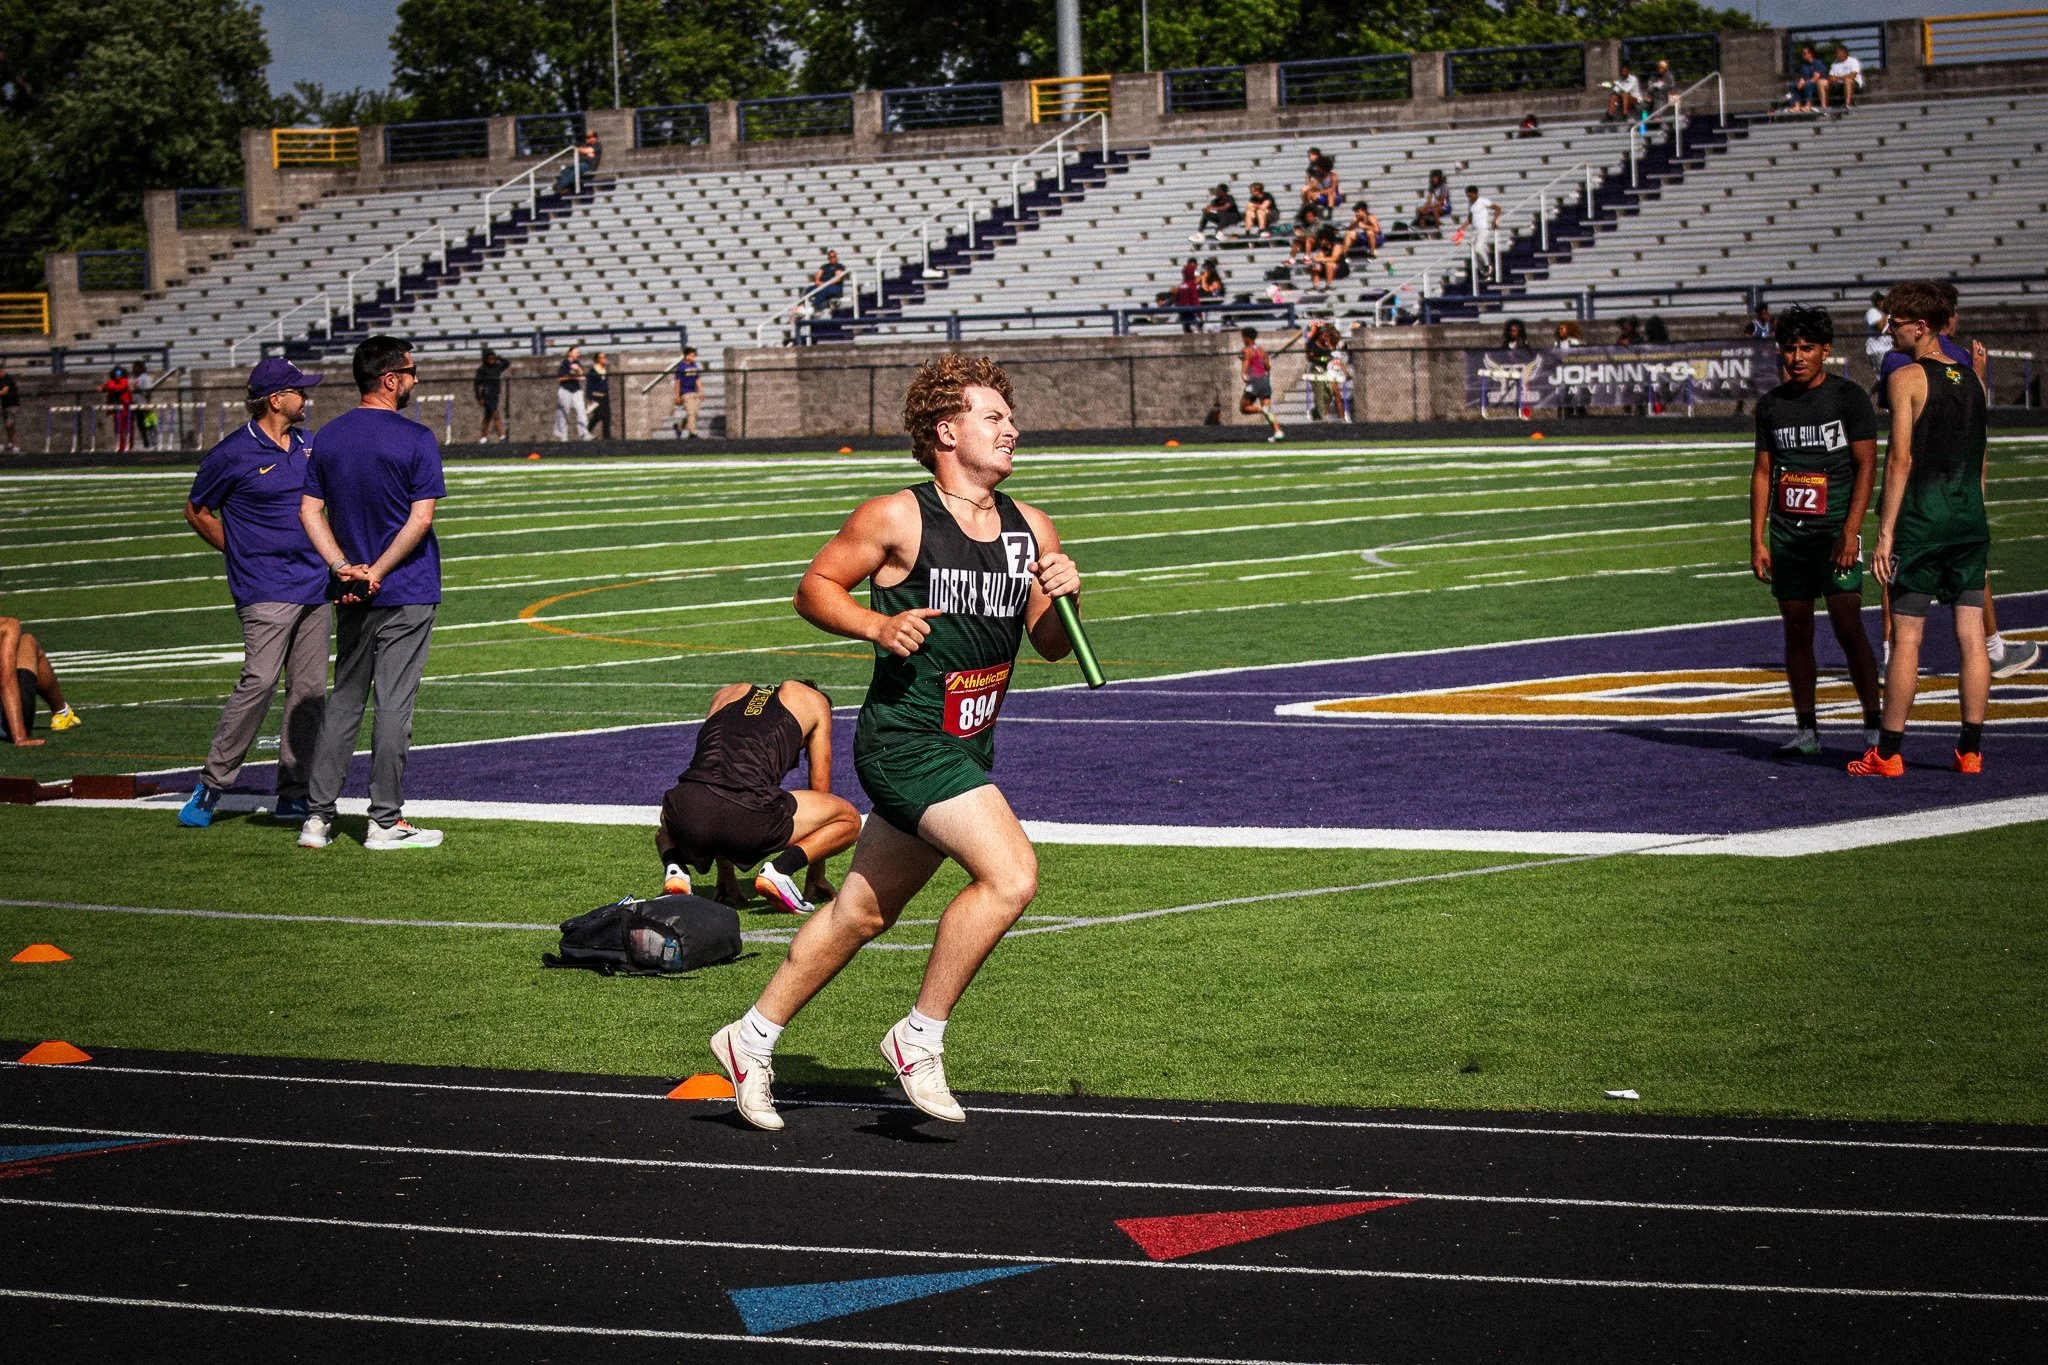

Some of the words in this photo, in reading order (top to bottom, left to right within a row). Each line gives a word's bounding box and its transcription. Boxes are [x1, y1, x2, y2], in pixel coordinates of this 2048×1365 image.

[1548, 363, 1664, 385] JOHNNY
[1555, 380, 1748, 394] INVITATINAL
[1774, 426, 1797, 448] RTH
[1785, 487, 1817, 509] 872
[1007, 535, 1031, 574] 7
[959, 690, 998, 731] 894
